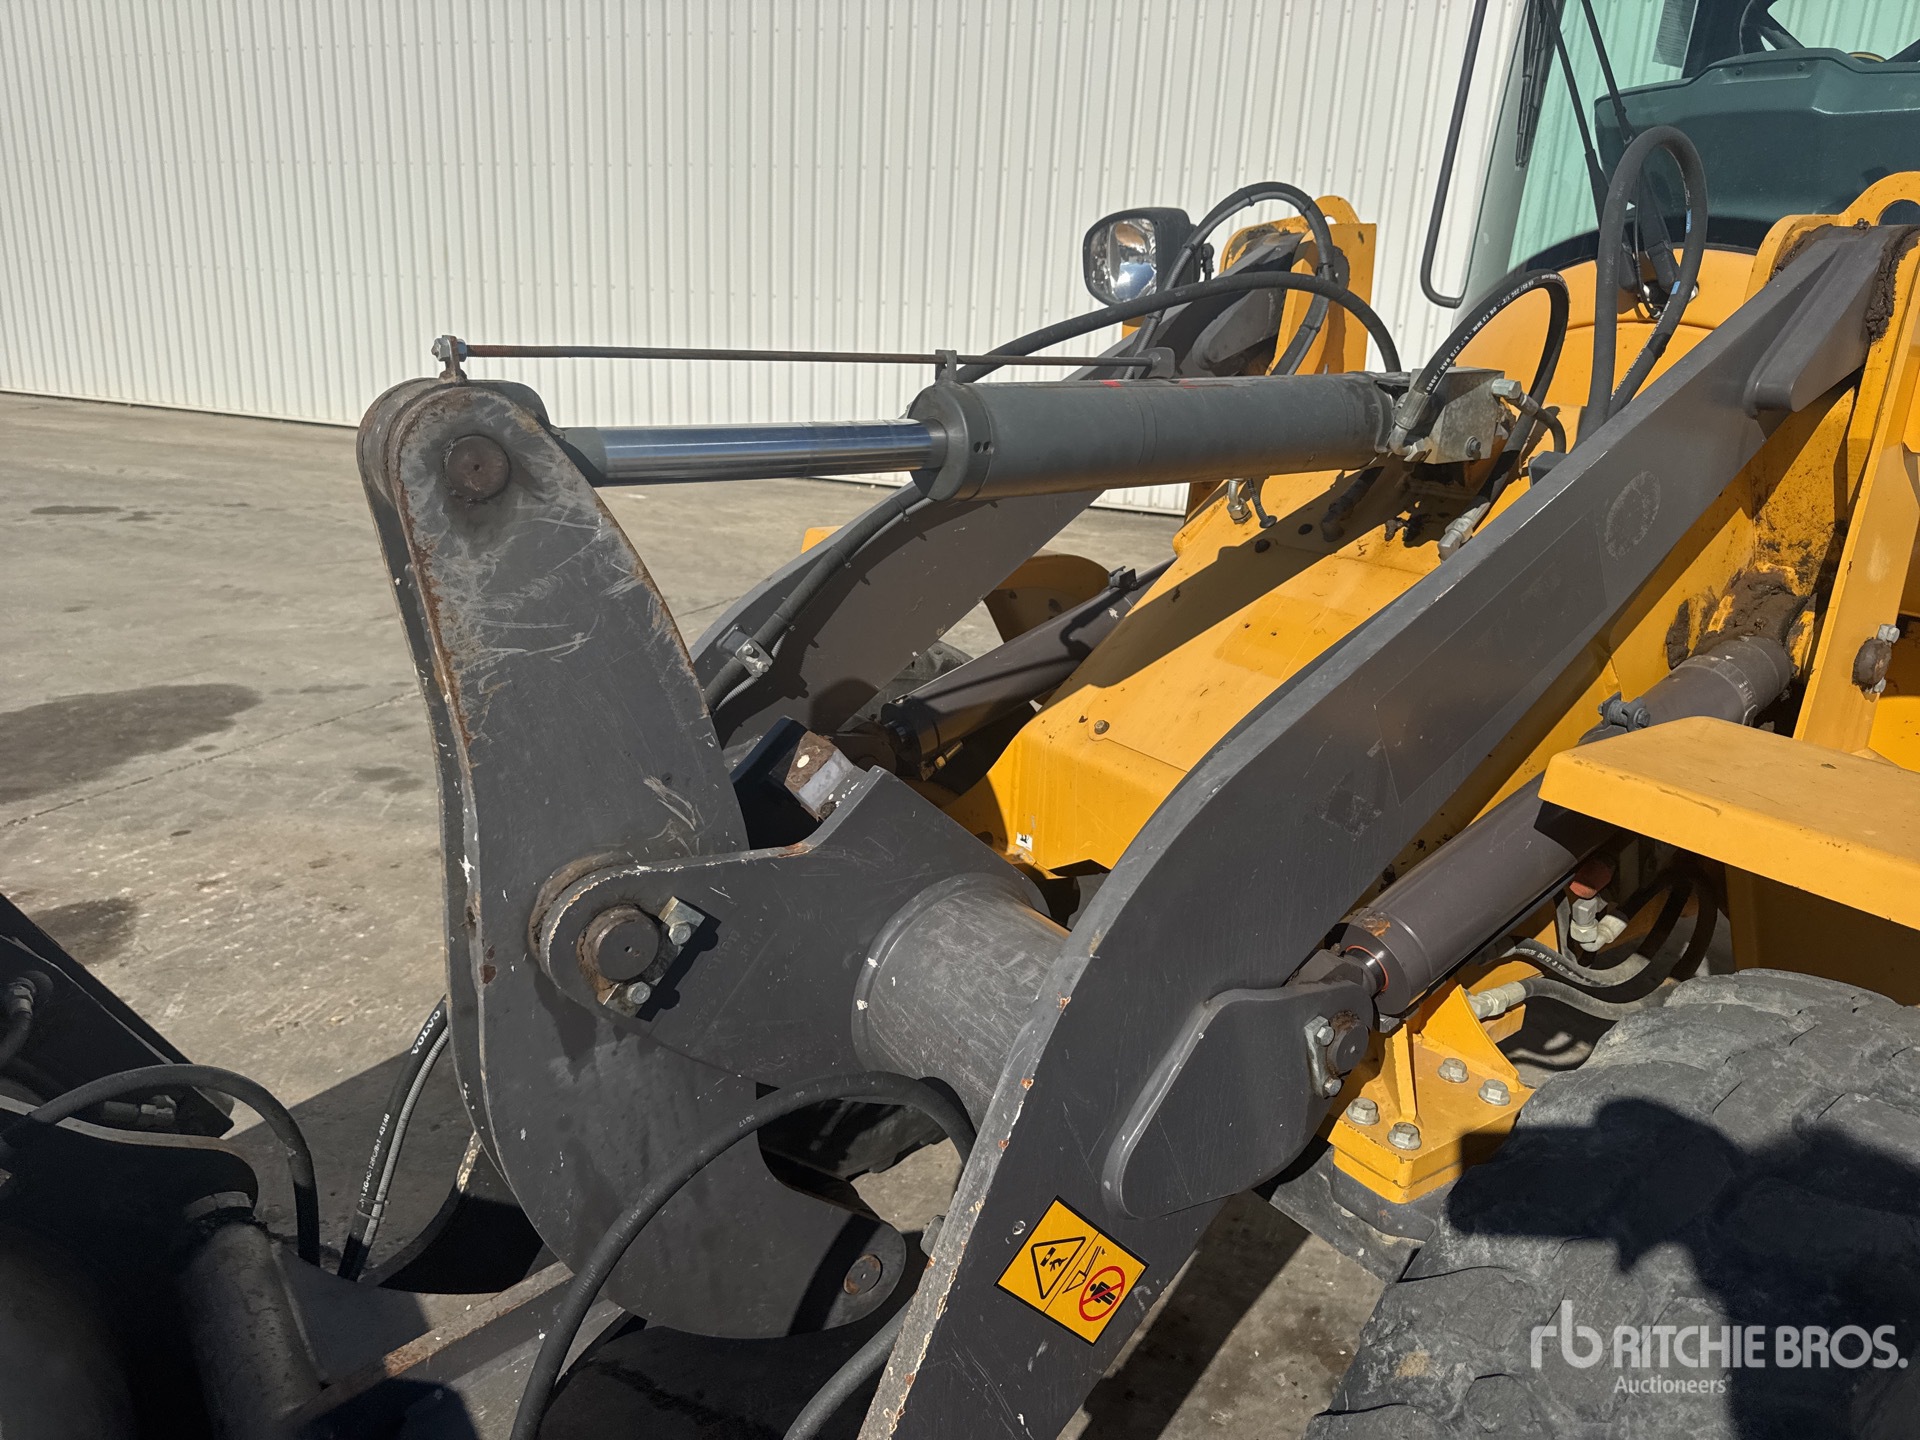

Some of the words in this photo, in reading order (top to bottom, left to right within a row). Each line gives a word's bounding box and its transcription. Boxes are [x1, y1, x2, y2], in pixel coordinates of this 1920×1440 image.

[1450, 345, 1460, 357] 275
[1440, 357, 1451, 371] BAR
[411, 1009, 440, 1056] VOLVO
[738, 1114, 755, 1128] 2017
